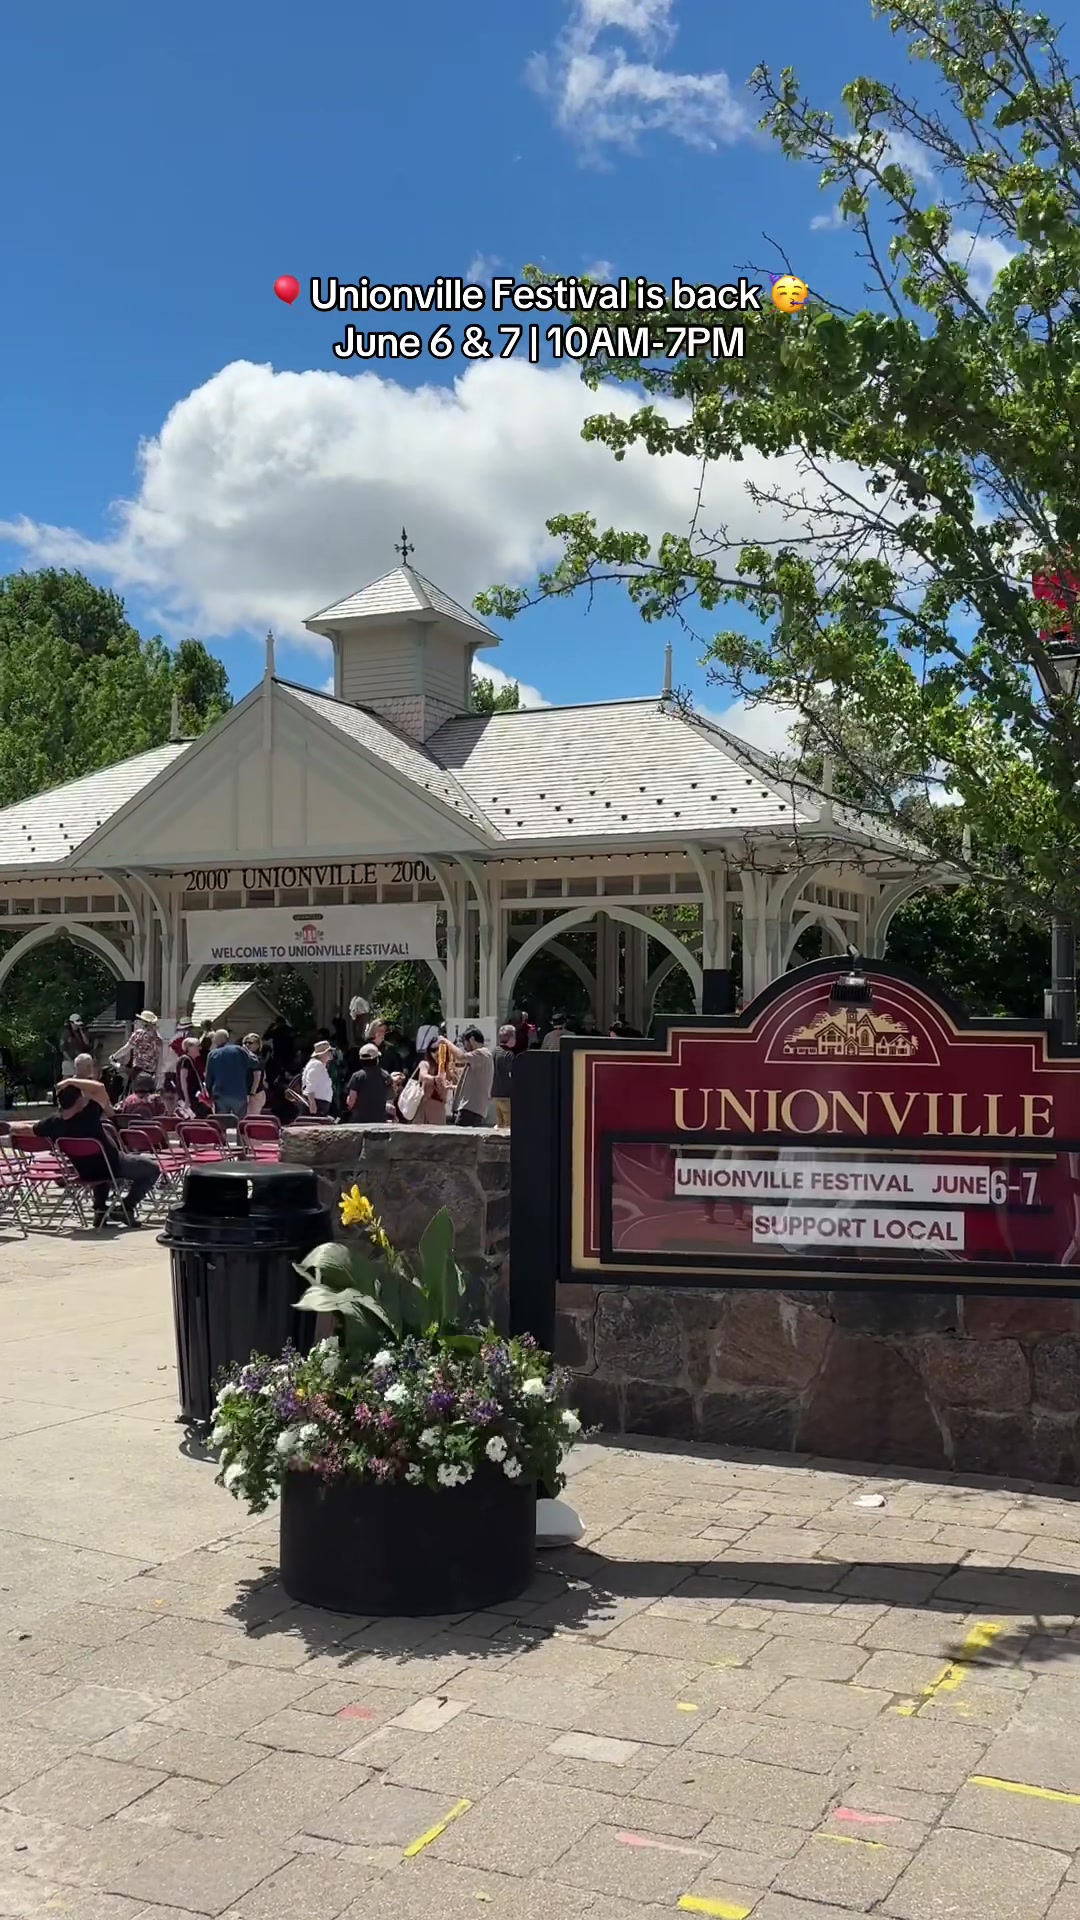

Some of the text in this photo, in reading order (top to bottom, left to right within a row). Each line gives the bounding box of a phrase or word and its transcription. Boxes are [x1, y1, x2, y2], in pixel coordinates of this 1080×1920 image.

[186, 869, 229, 891] 2000
[242, 863, 377, 889] UNIONVILLE
[211, 943, 409, 959] WELCOME TO UNIONVILLE FESTIVAL!
[671, 1087, 1056, 1138] UNIONVILLE
[676, 1167, 804, 1190] UNIONVILLE
[811, 1173, 914, 1193] FESTIVAL
[755, 1216, 958, 1242] SUPPORT LOCAL
